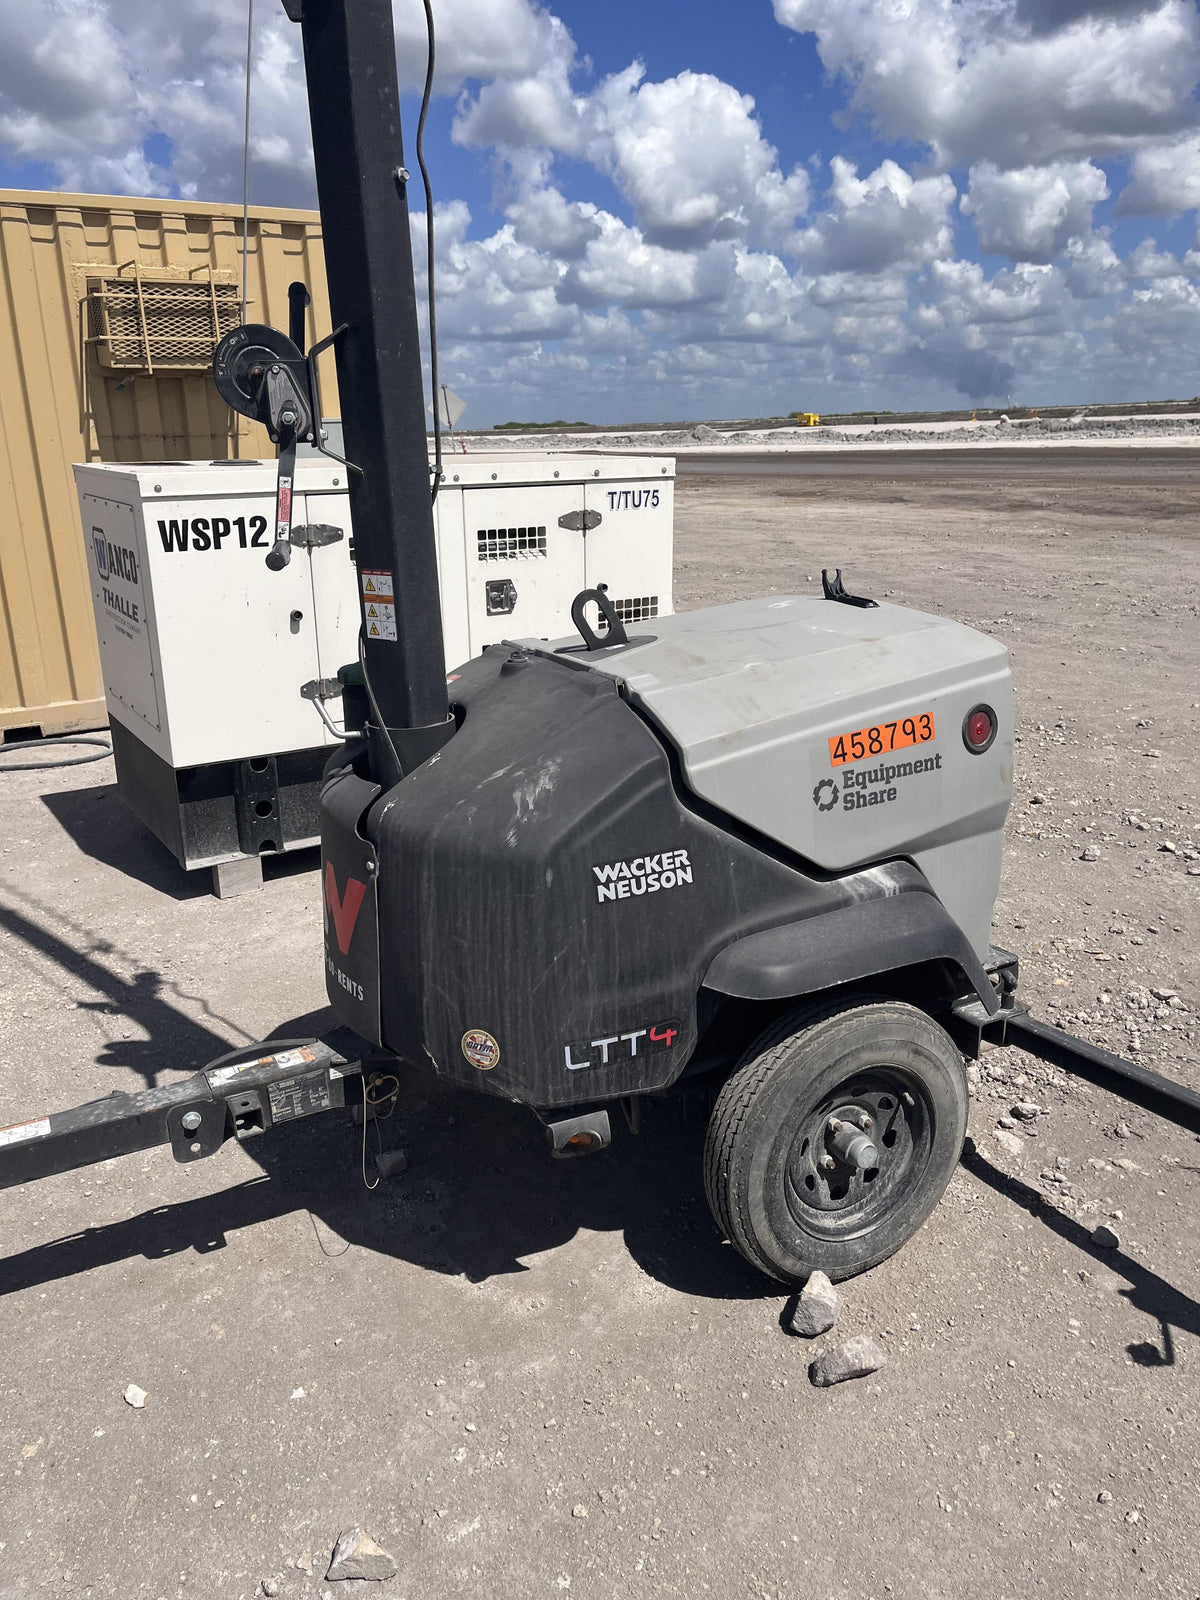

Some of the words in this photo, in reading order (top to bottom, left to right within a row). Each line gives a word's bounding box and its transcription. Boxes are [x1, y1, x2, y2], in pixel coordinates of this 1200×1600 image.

[607, 489, 660, 510] T/TU75
[157, 515, 269, 553] WSP12
[94, 537, 139, 585] WANCO
[102, 586, 140, 623] THALLE
[833, 714, 932, 762] 458793
[842, 753, 942, 790] Equipment
[843, 787, 897, 811] Share
[593, 849, 691, 883] WACKER
[597, 866, 693, 902] NEUSON
[564, 1026, 677, 1070] LTT4
